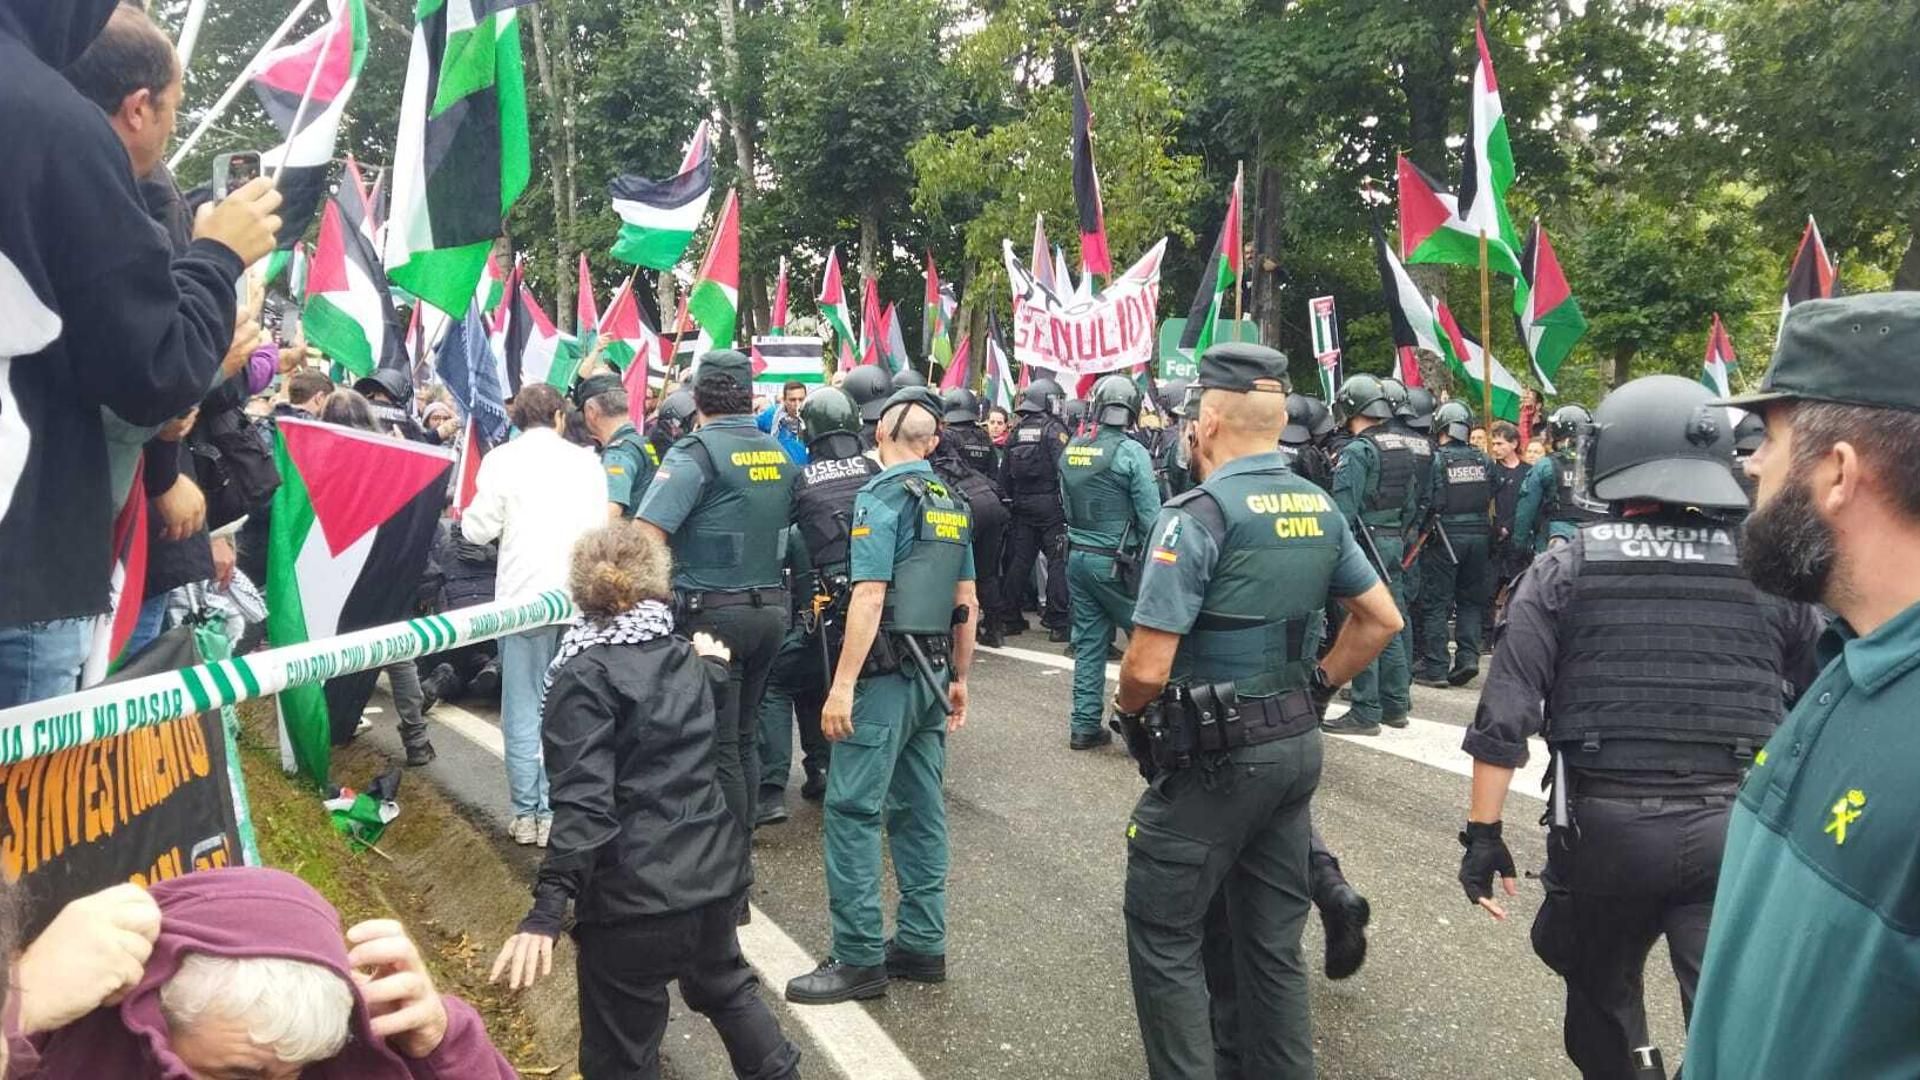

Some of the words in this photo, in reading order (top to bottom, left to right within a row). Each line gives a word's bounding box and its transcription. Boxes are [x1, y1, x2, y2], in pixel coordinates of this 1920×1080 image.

[731, 450, 787, 466] GUARDIA
[804, 456, 865, 478] USECIC
[1068, 456, 1092, 466] CIVIL
[749, 465, 781, 481] CIVIL
[807, 472, 845, 485] GUARDIA
[846, 466, 867, 477] CIVIL
[1447, 465, 1486, 477] USECIC
[1246, 492, 1332, 514] GUARDIA
[926, 510, 968, 529] GUARDIA
[1275, 516, 1324, 539] CIVIL
[935, 524, 960, 540] CIVIL
[1590, 522, 1731, 545] GUARDIA
[1621, 539, 1705, 560] CIVIL
[286, 652, 337, 687] GUARDIA
[369, 641, 385, 666] NO
[385, 632, 416, 661] PASAR
[93, 702, 119, 742] NO
[126, 688, 183, 732] PASAR
